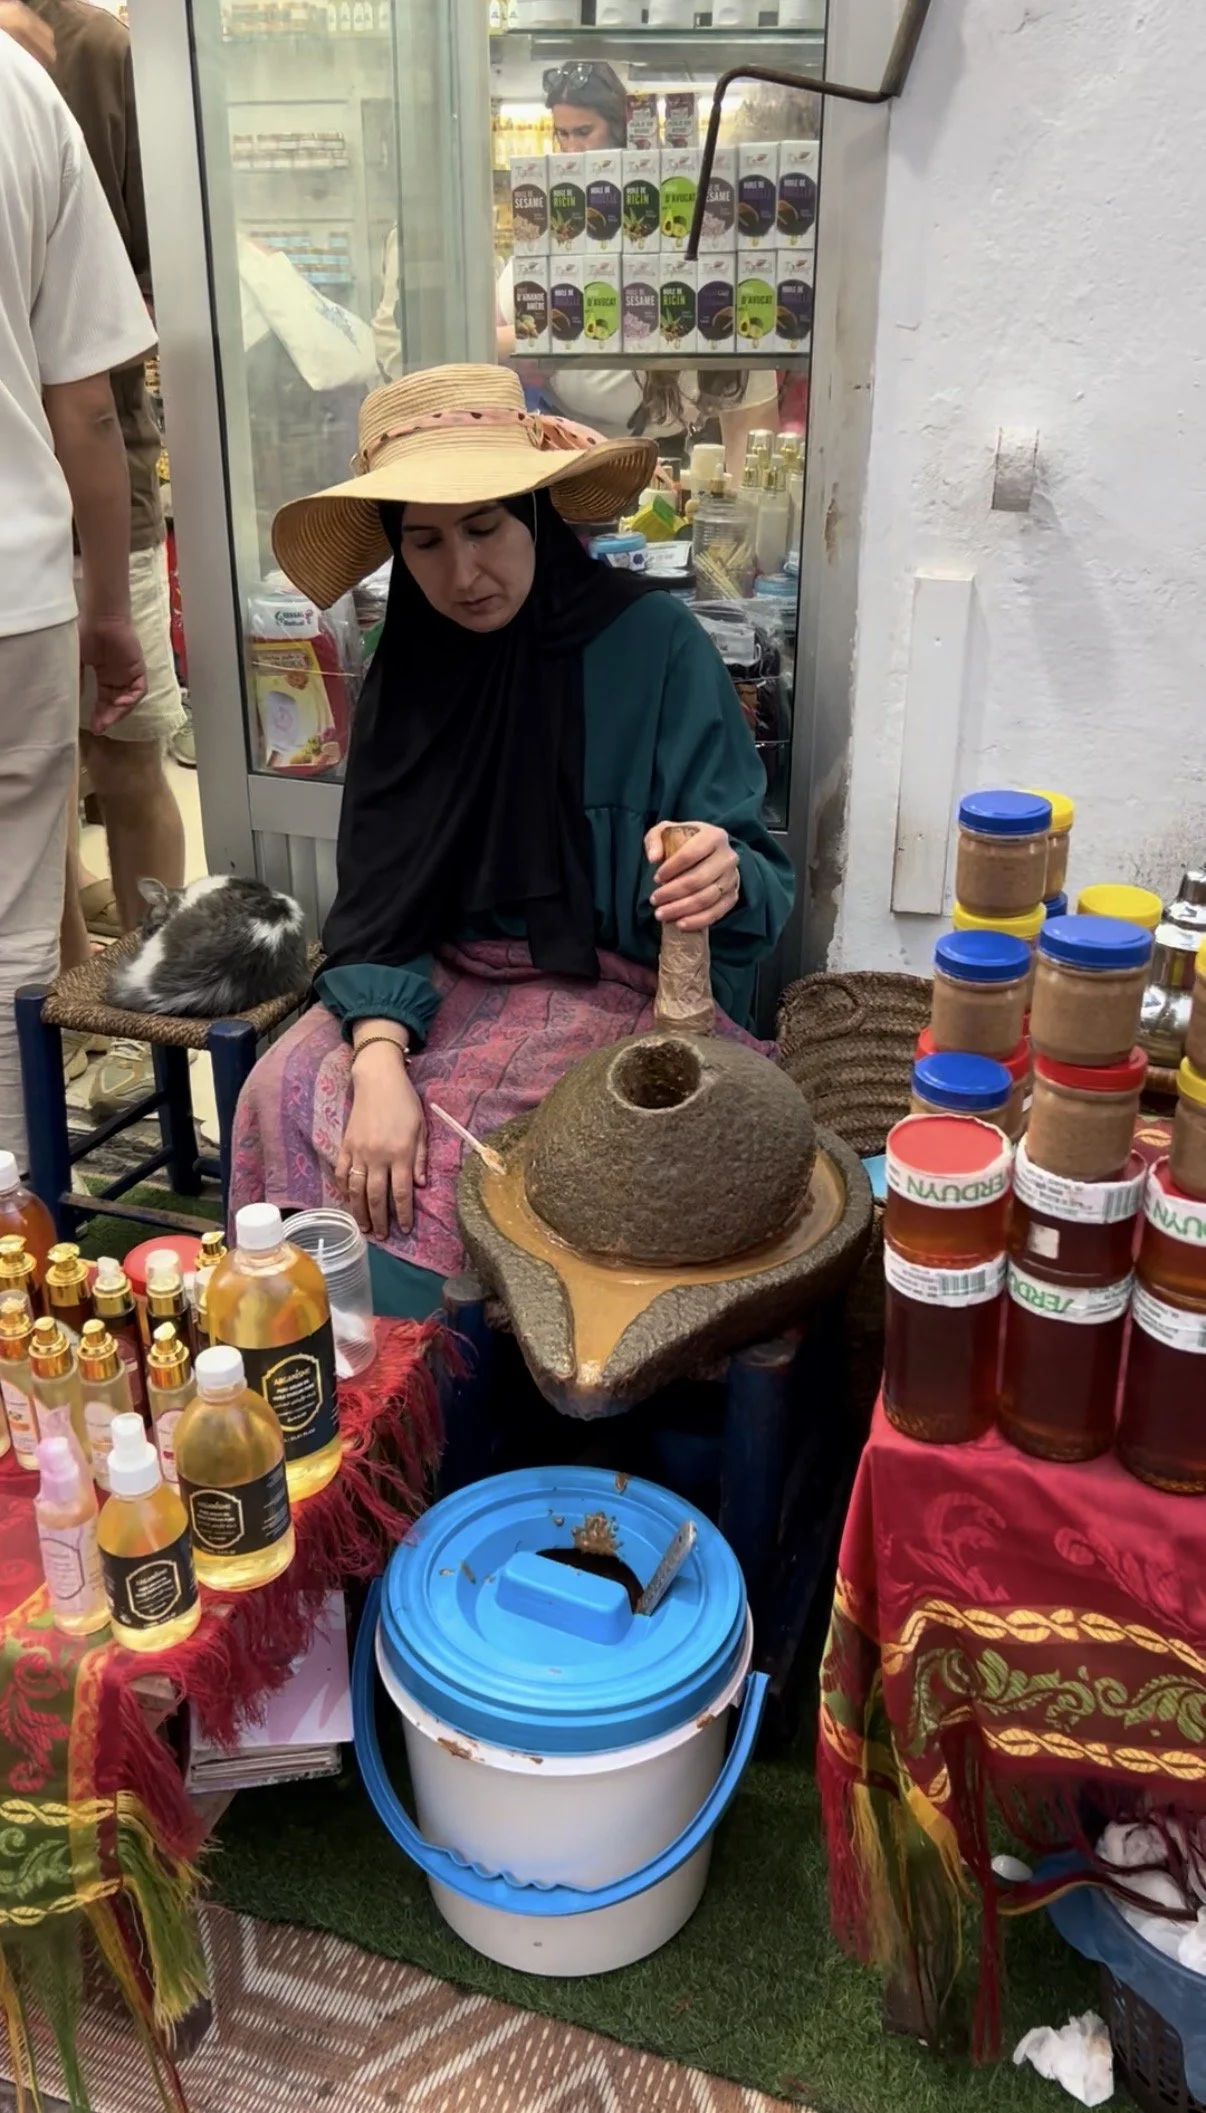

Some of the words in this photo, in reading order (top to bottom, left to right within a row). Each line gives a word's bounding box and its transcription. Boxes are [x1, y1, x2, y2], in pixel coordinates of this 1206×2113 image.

[706, 190, 731, 203] ESAME
[514, 197, 544, 209] SESAME
[625, 295, 656, 307] SESAME
[662, 295, 687, 306] RICIN
[907, 1173, 1004, 1203] ERDUYN
[1153, 1199, 1206, 1240] UYN
